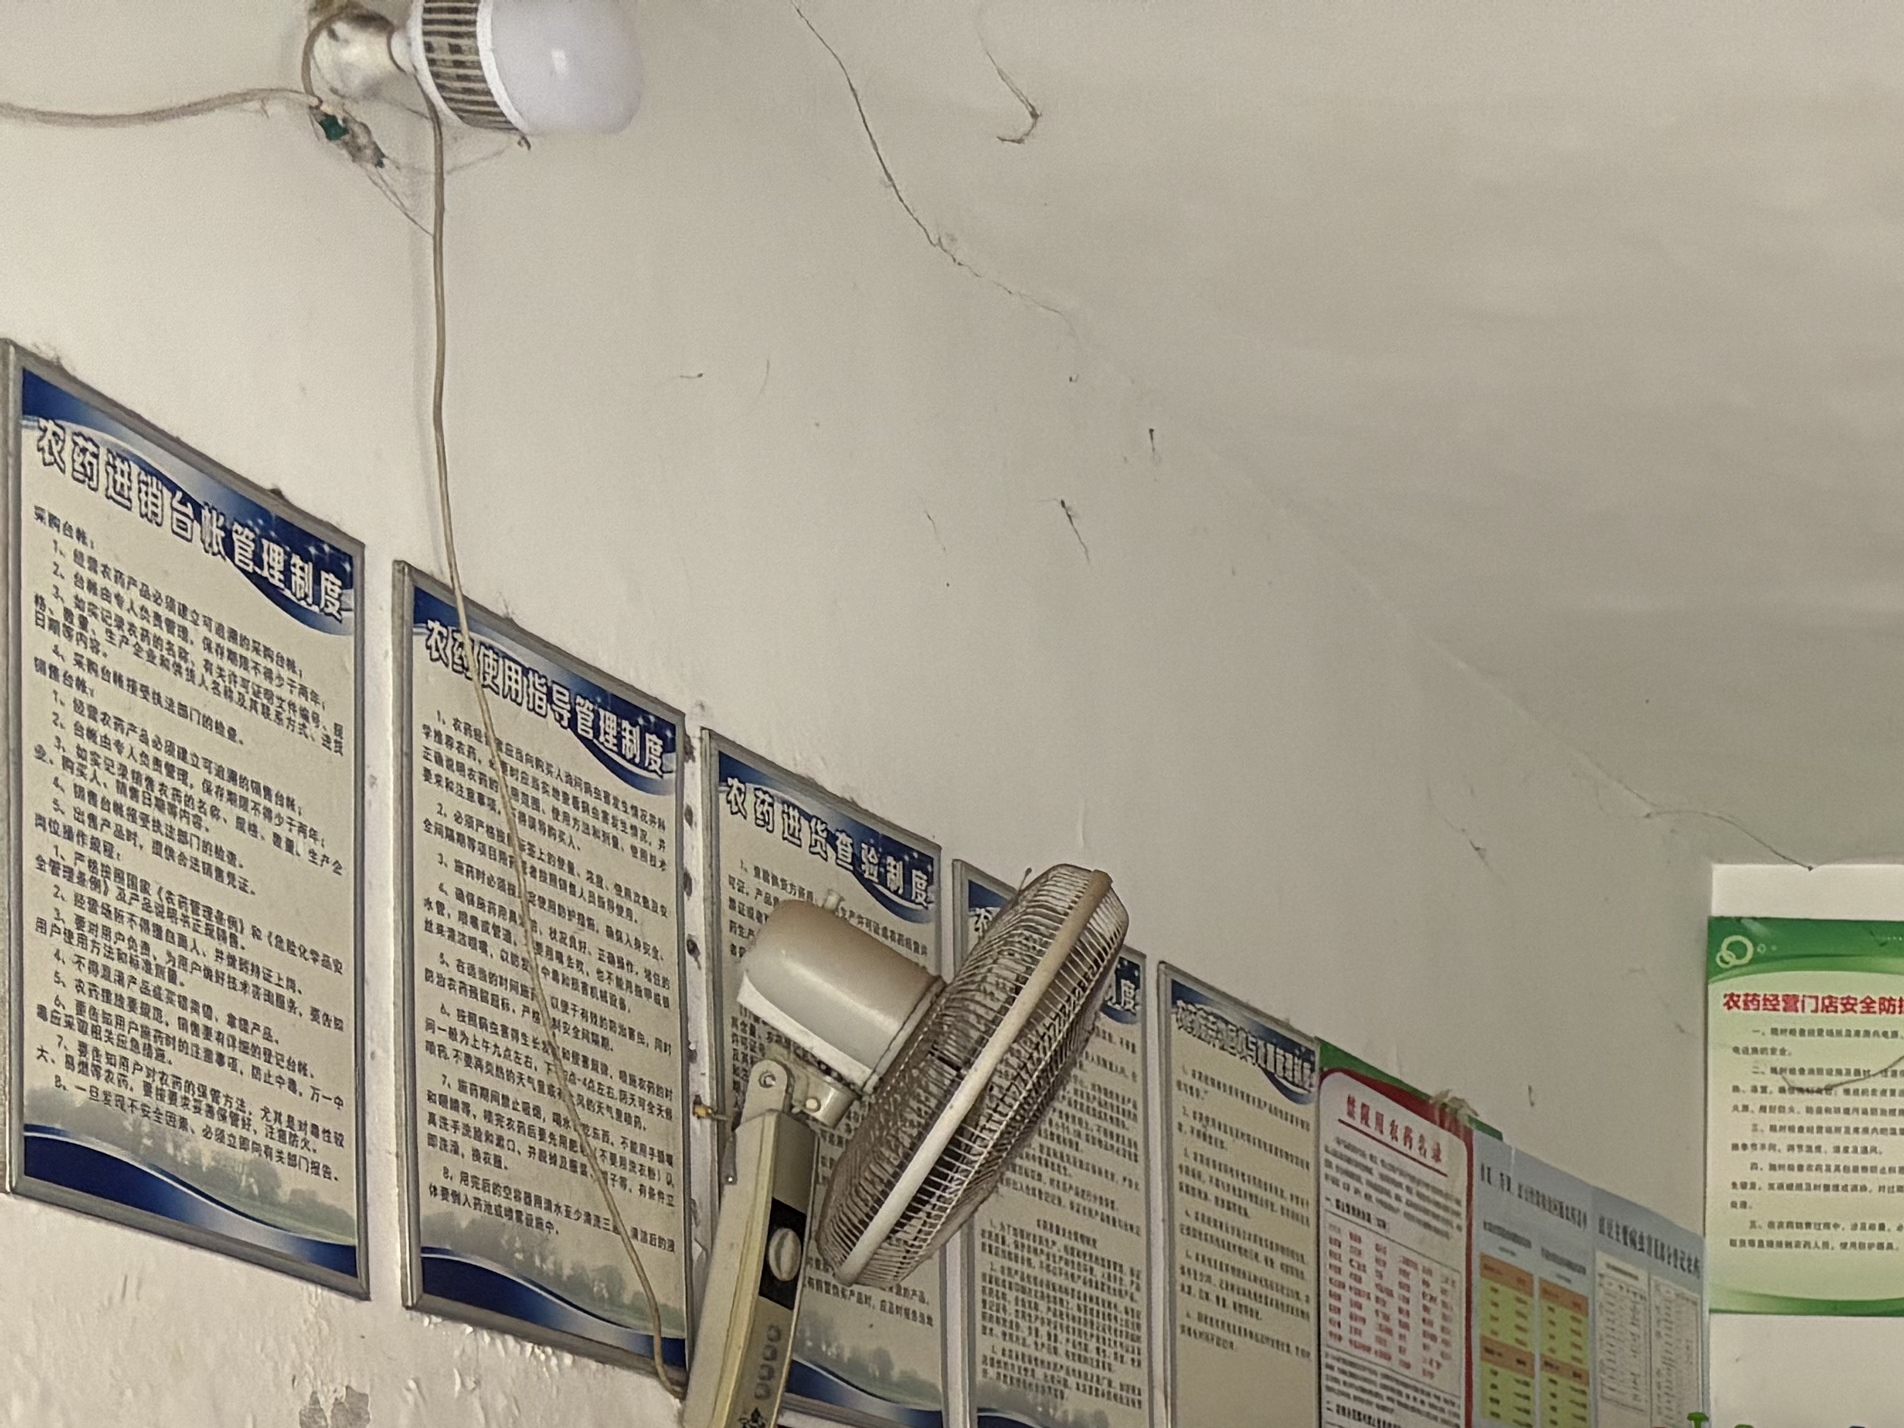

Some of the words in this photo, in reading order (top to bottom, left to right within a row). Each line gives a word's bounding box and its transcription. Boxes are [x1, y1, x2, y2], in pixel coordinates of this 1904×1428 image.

[37, 417, 344, 624] 农药进销台帐管理制度
[725, 778, 935, 910] 农药进货查验制度
